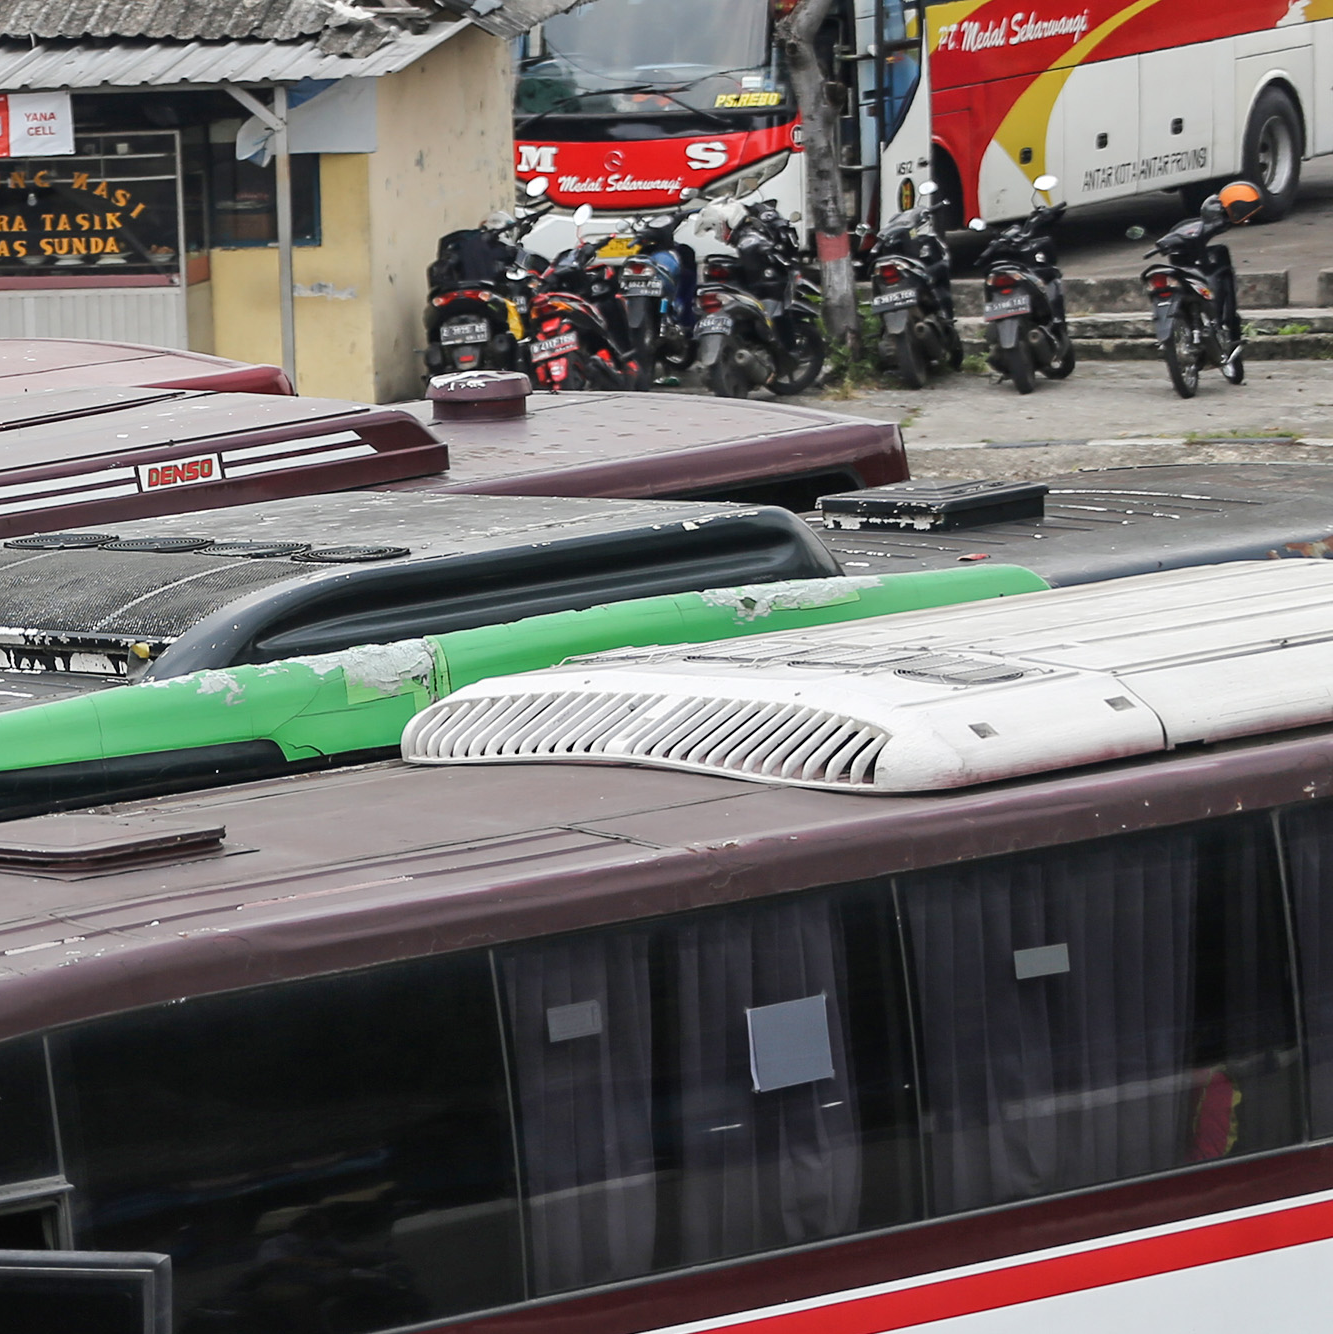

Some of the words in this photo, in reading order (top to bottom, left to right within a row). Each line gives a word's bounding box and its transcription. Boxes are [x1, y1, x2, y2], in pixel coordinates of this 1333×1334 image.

[960, 17, 1008, 52] Medal
[24, 112, 56, 122] YANA
[27, 127, 56, 136] CELL
[516, 145, 559, 173] M
[685, 141, 728, 170] S
[558, 174, 604, 193] Medal
[40, 212, 123, 231] TASIK
[38, 236, 121, 255] SUNDA
[148, 458, 213, 488] DENSO
